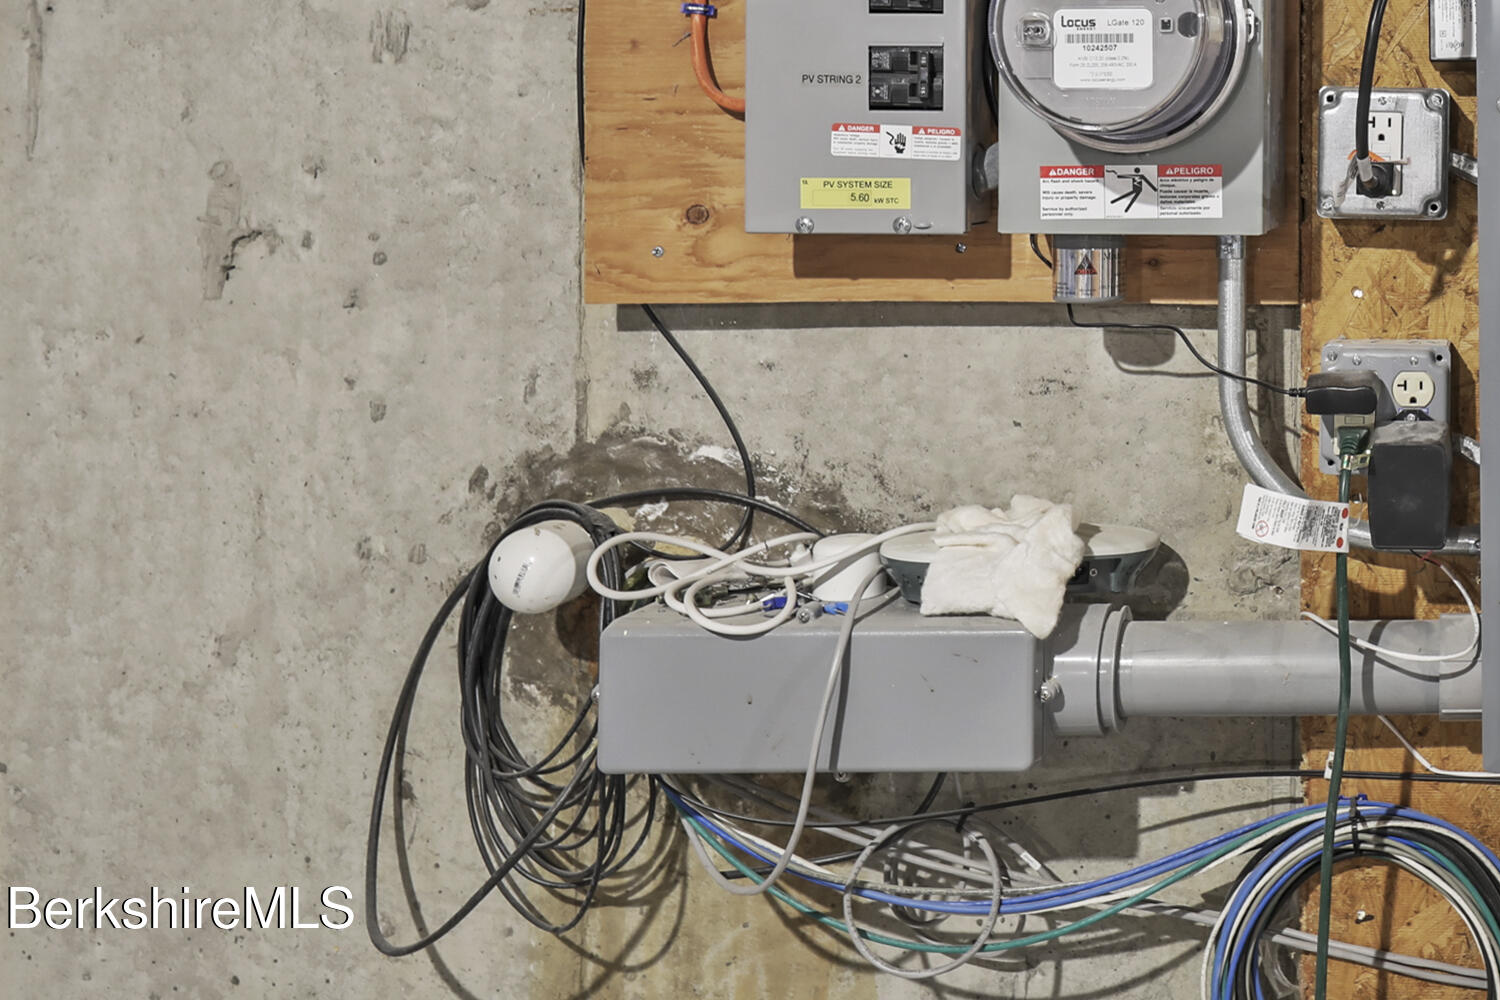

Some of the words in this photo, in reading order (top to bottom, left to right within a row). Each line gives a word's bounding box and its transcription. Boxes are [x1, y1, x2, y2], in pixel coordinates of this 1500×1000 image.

[1060, 15, 1097, 28] Locus
[1106, 18, 1129, 27] LGate
[1132, 18, 1145, 26] 120
[1082, 44, 1118, 52] 10242507
[801, 74, 815, 84] PV
[816, 73, 854, 84] STRING
[855, 74, 862, 84] 2
[1056, 168, 1095, 176] DANGER
[1174, 167, 1214, 175] PELIGRO
[823, 180, 836, 189] PV
[836, 180, 873, 189] SYSTEM
[873, 180, 893, 189] SIZE
[850, 193, 870, 202] 5.60
